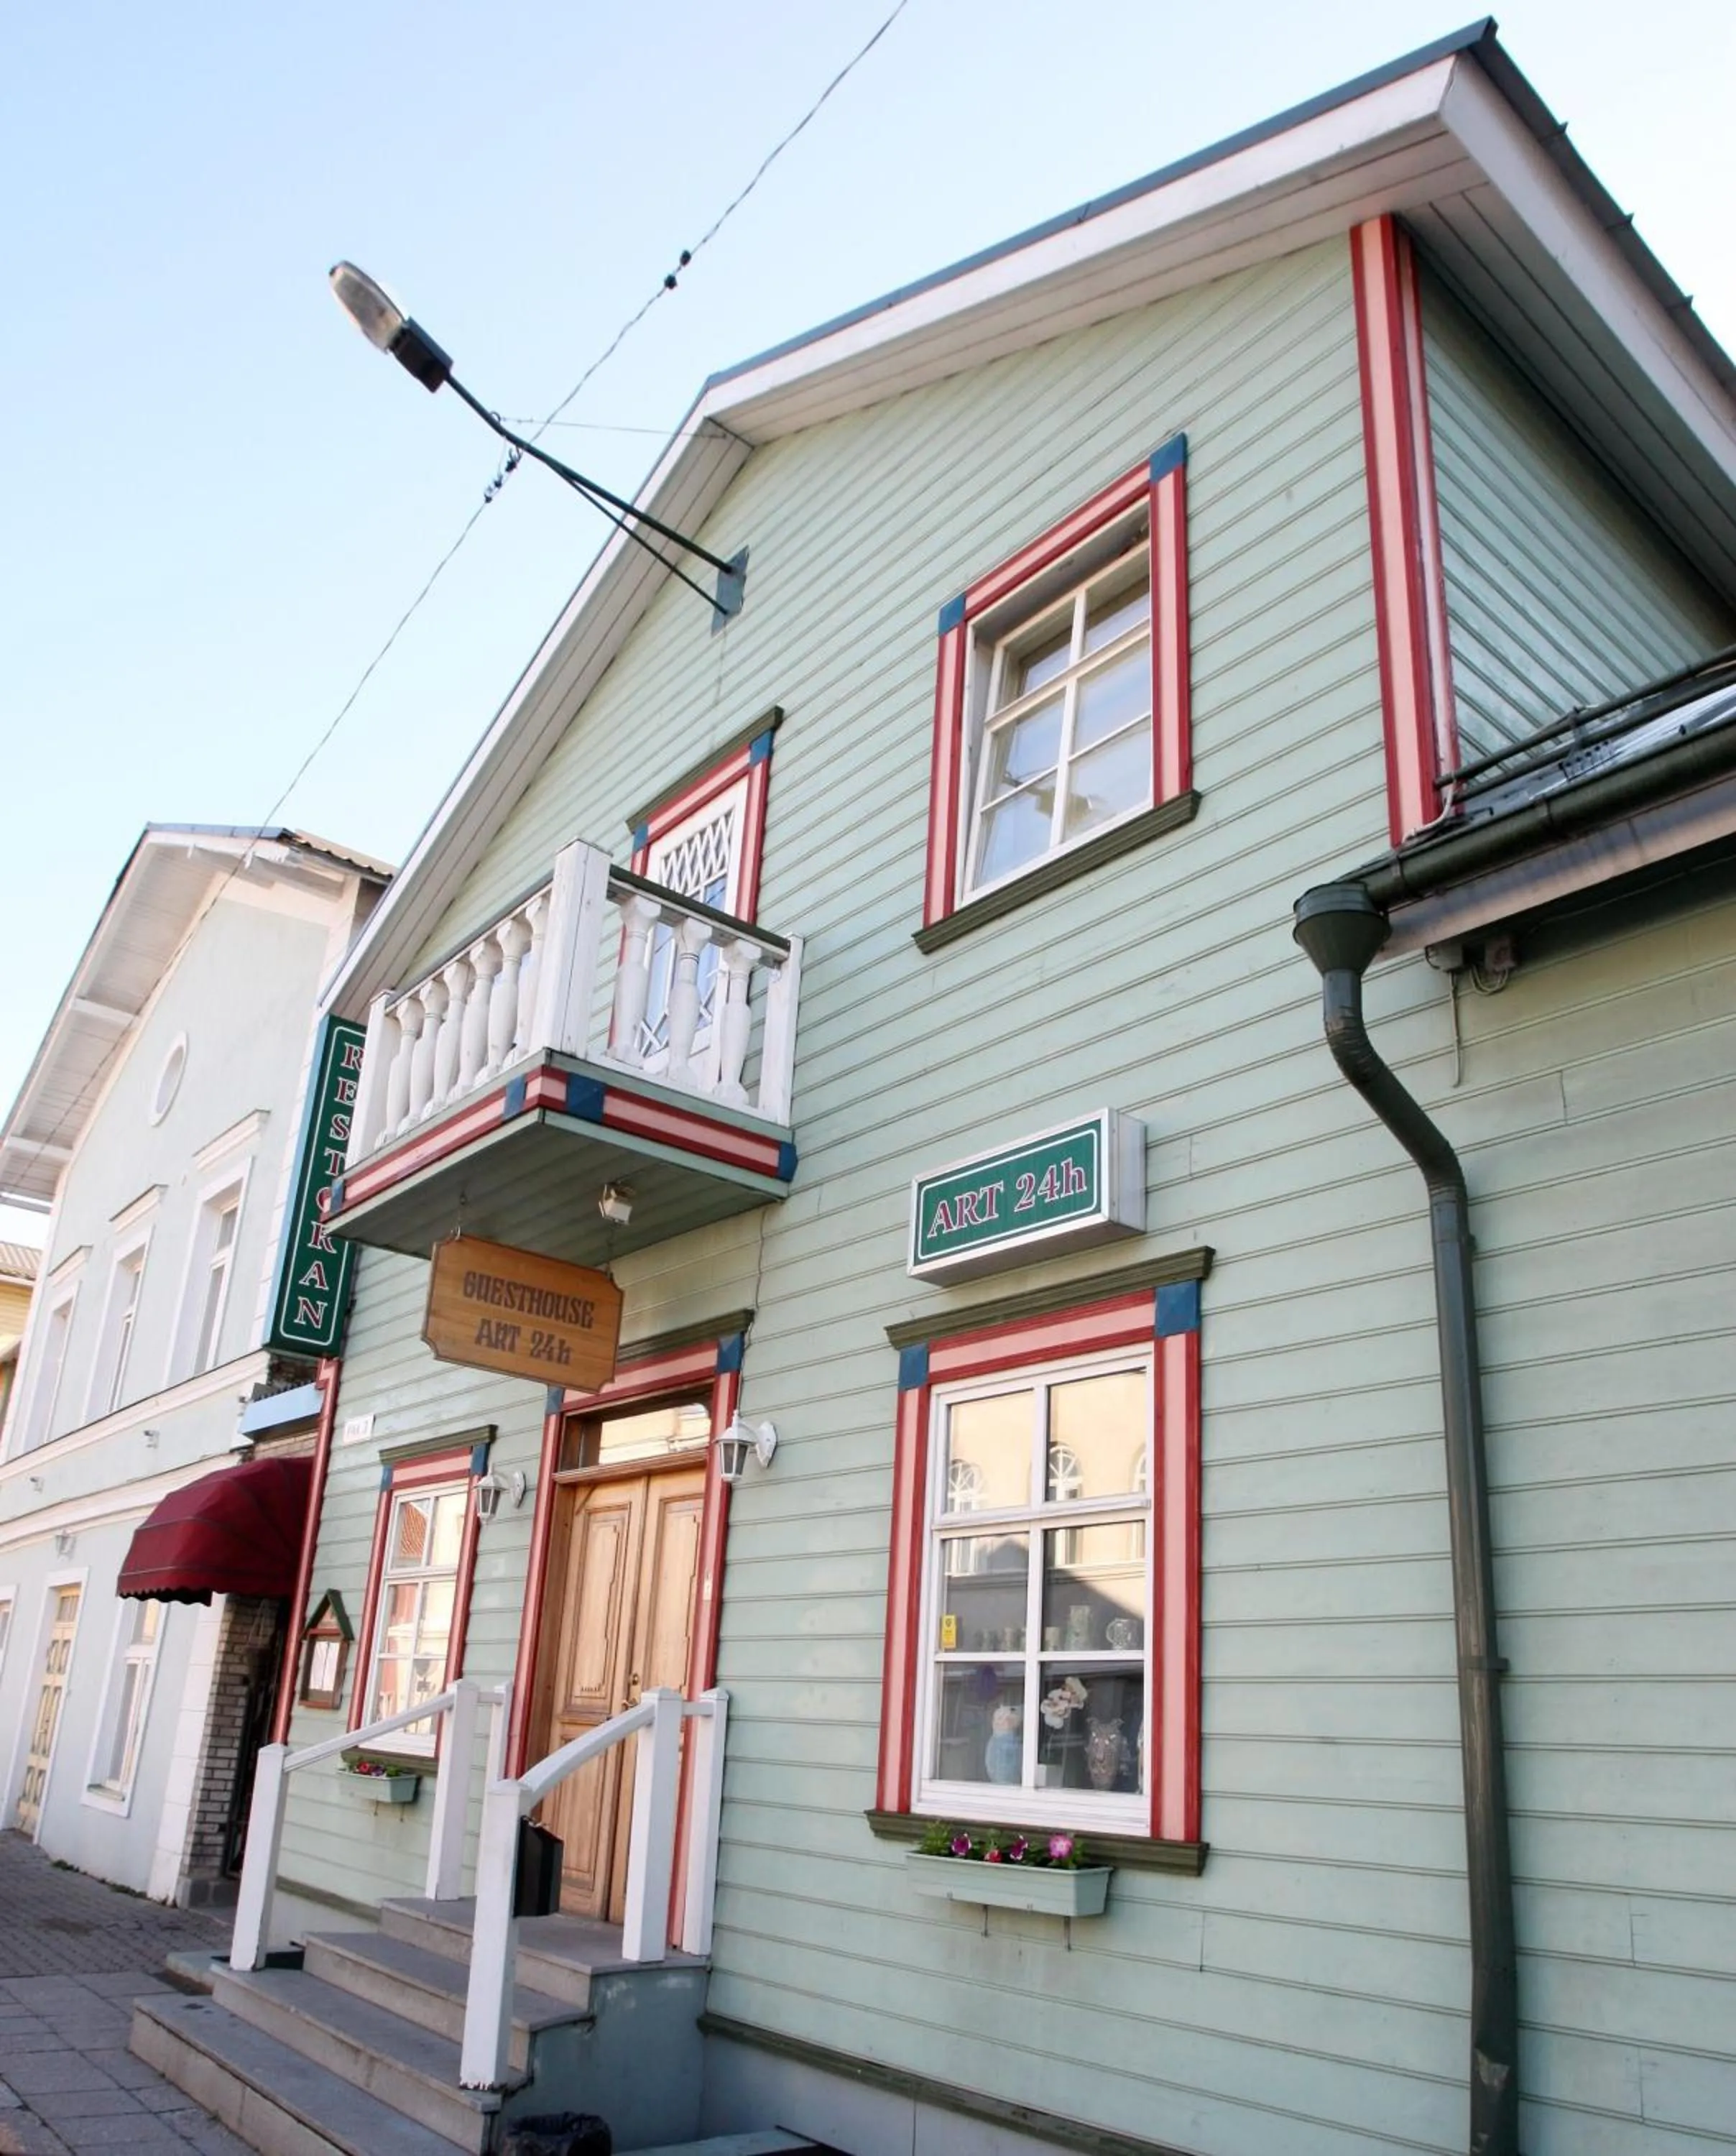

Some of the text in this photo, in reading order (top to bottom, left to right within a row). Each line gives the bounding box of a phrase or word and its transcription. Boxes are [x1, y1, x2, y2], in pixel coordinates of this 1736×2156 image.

[926, 1157, 1087, 1238] ART 24h
[463, 1271, 595, 1330] GUESTHOUSE
[474, 1318, 573, 1365] ART 24h
